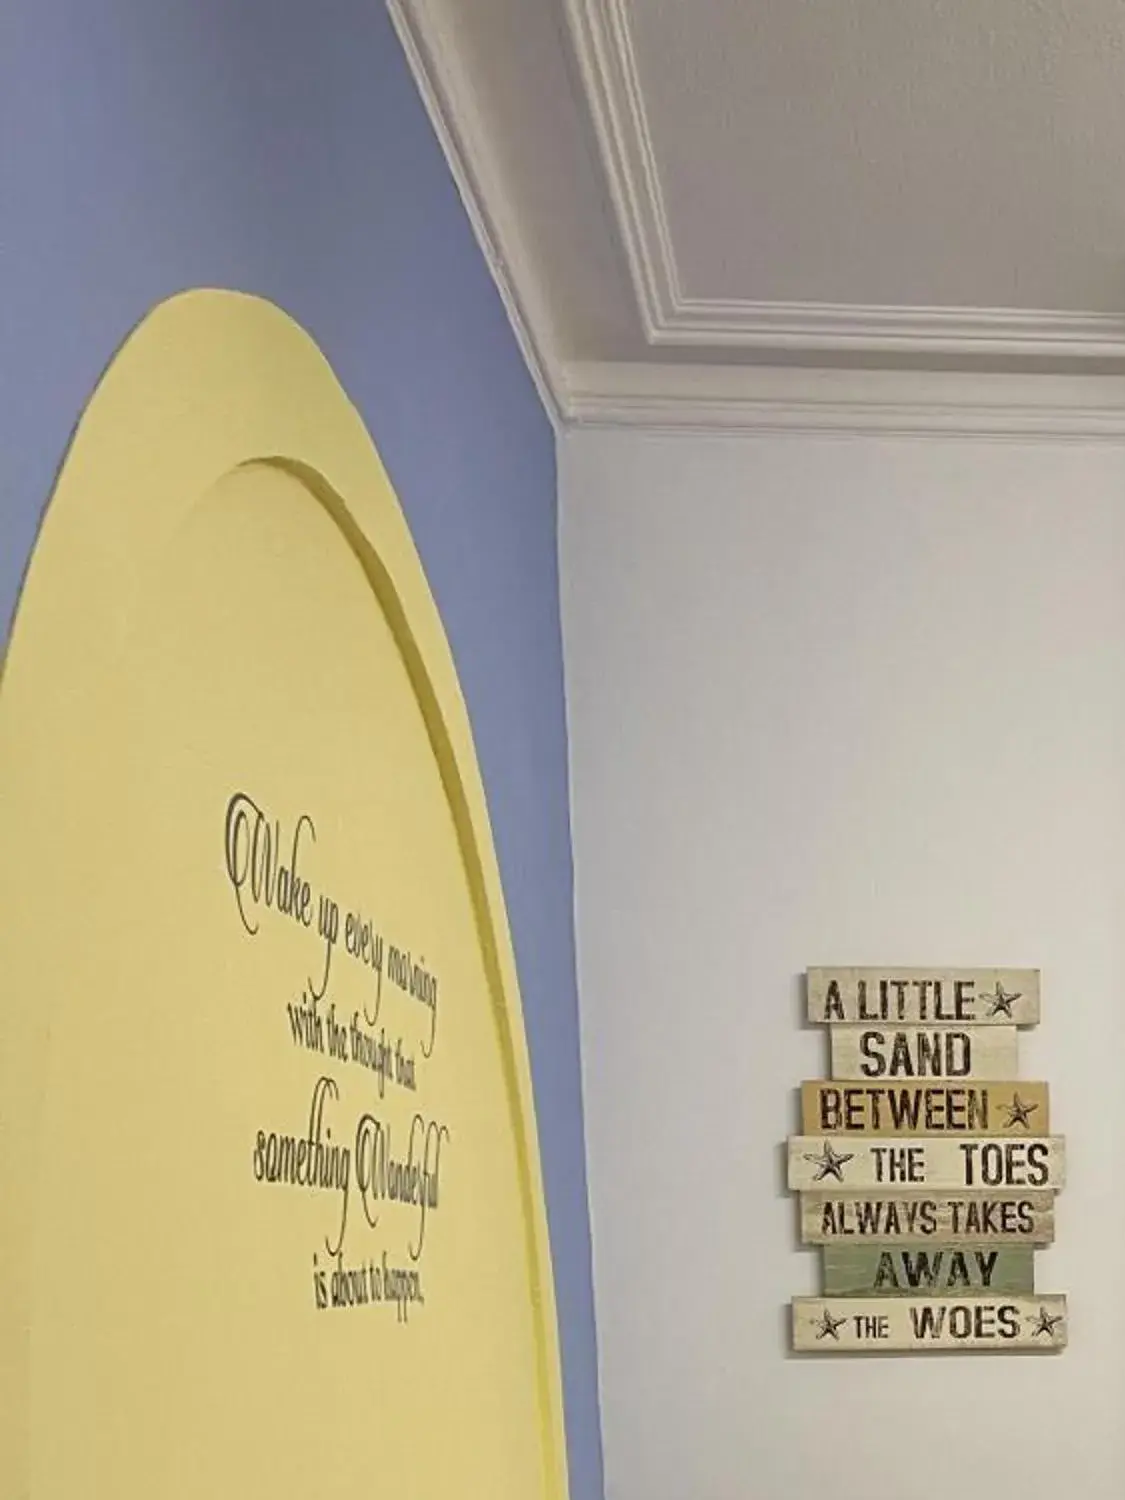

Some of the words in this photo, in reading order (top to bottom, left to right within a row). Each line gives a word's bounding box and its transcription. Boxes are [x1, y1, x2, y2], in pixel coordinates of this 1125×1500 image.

[225, 792, 316, 936] Wake
[306, 894, 339, 1001] up
[345, 912, 383, 1027] every
[823, 979, 845, 1020] A
[857, 979, 976, 1021] LITTLE
[286, 991, 325, 1054] with
[326, 1003, 348, 1063] the
[859, 1031, 972, 1077] SAND
[819, 1089, 989, 1131] BETWEEN
[253, 1076, 350, 1256] something
[869, 1147, 925, 1182] THE
[959, 1143, 1049, 1187] TOES
[821, 1201, 938, 1236] ALWAYS
[948, 1201, 1035, 1235] TAKES
[313, 1252, 328, 1309] is
[873, 1251, 999, 1288] AWAY
[853, 1315, 889, 1339] THE
[909, 1305, 1021, 1339] WOES
